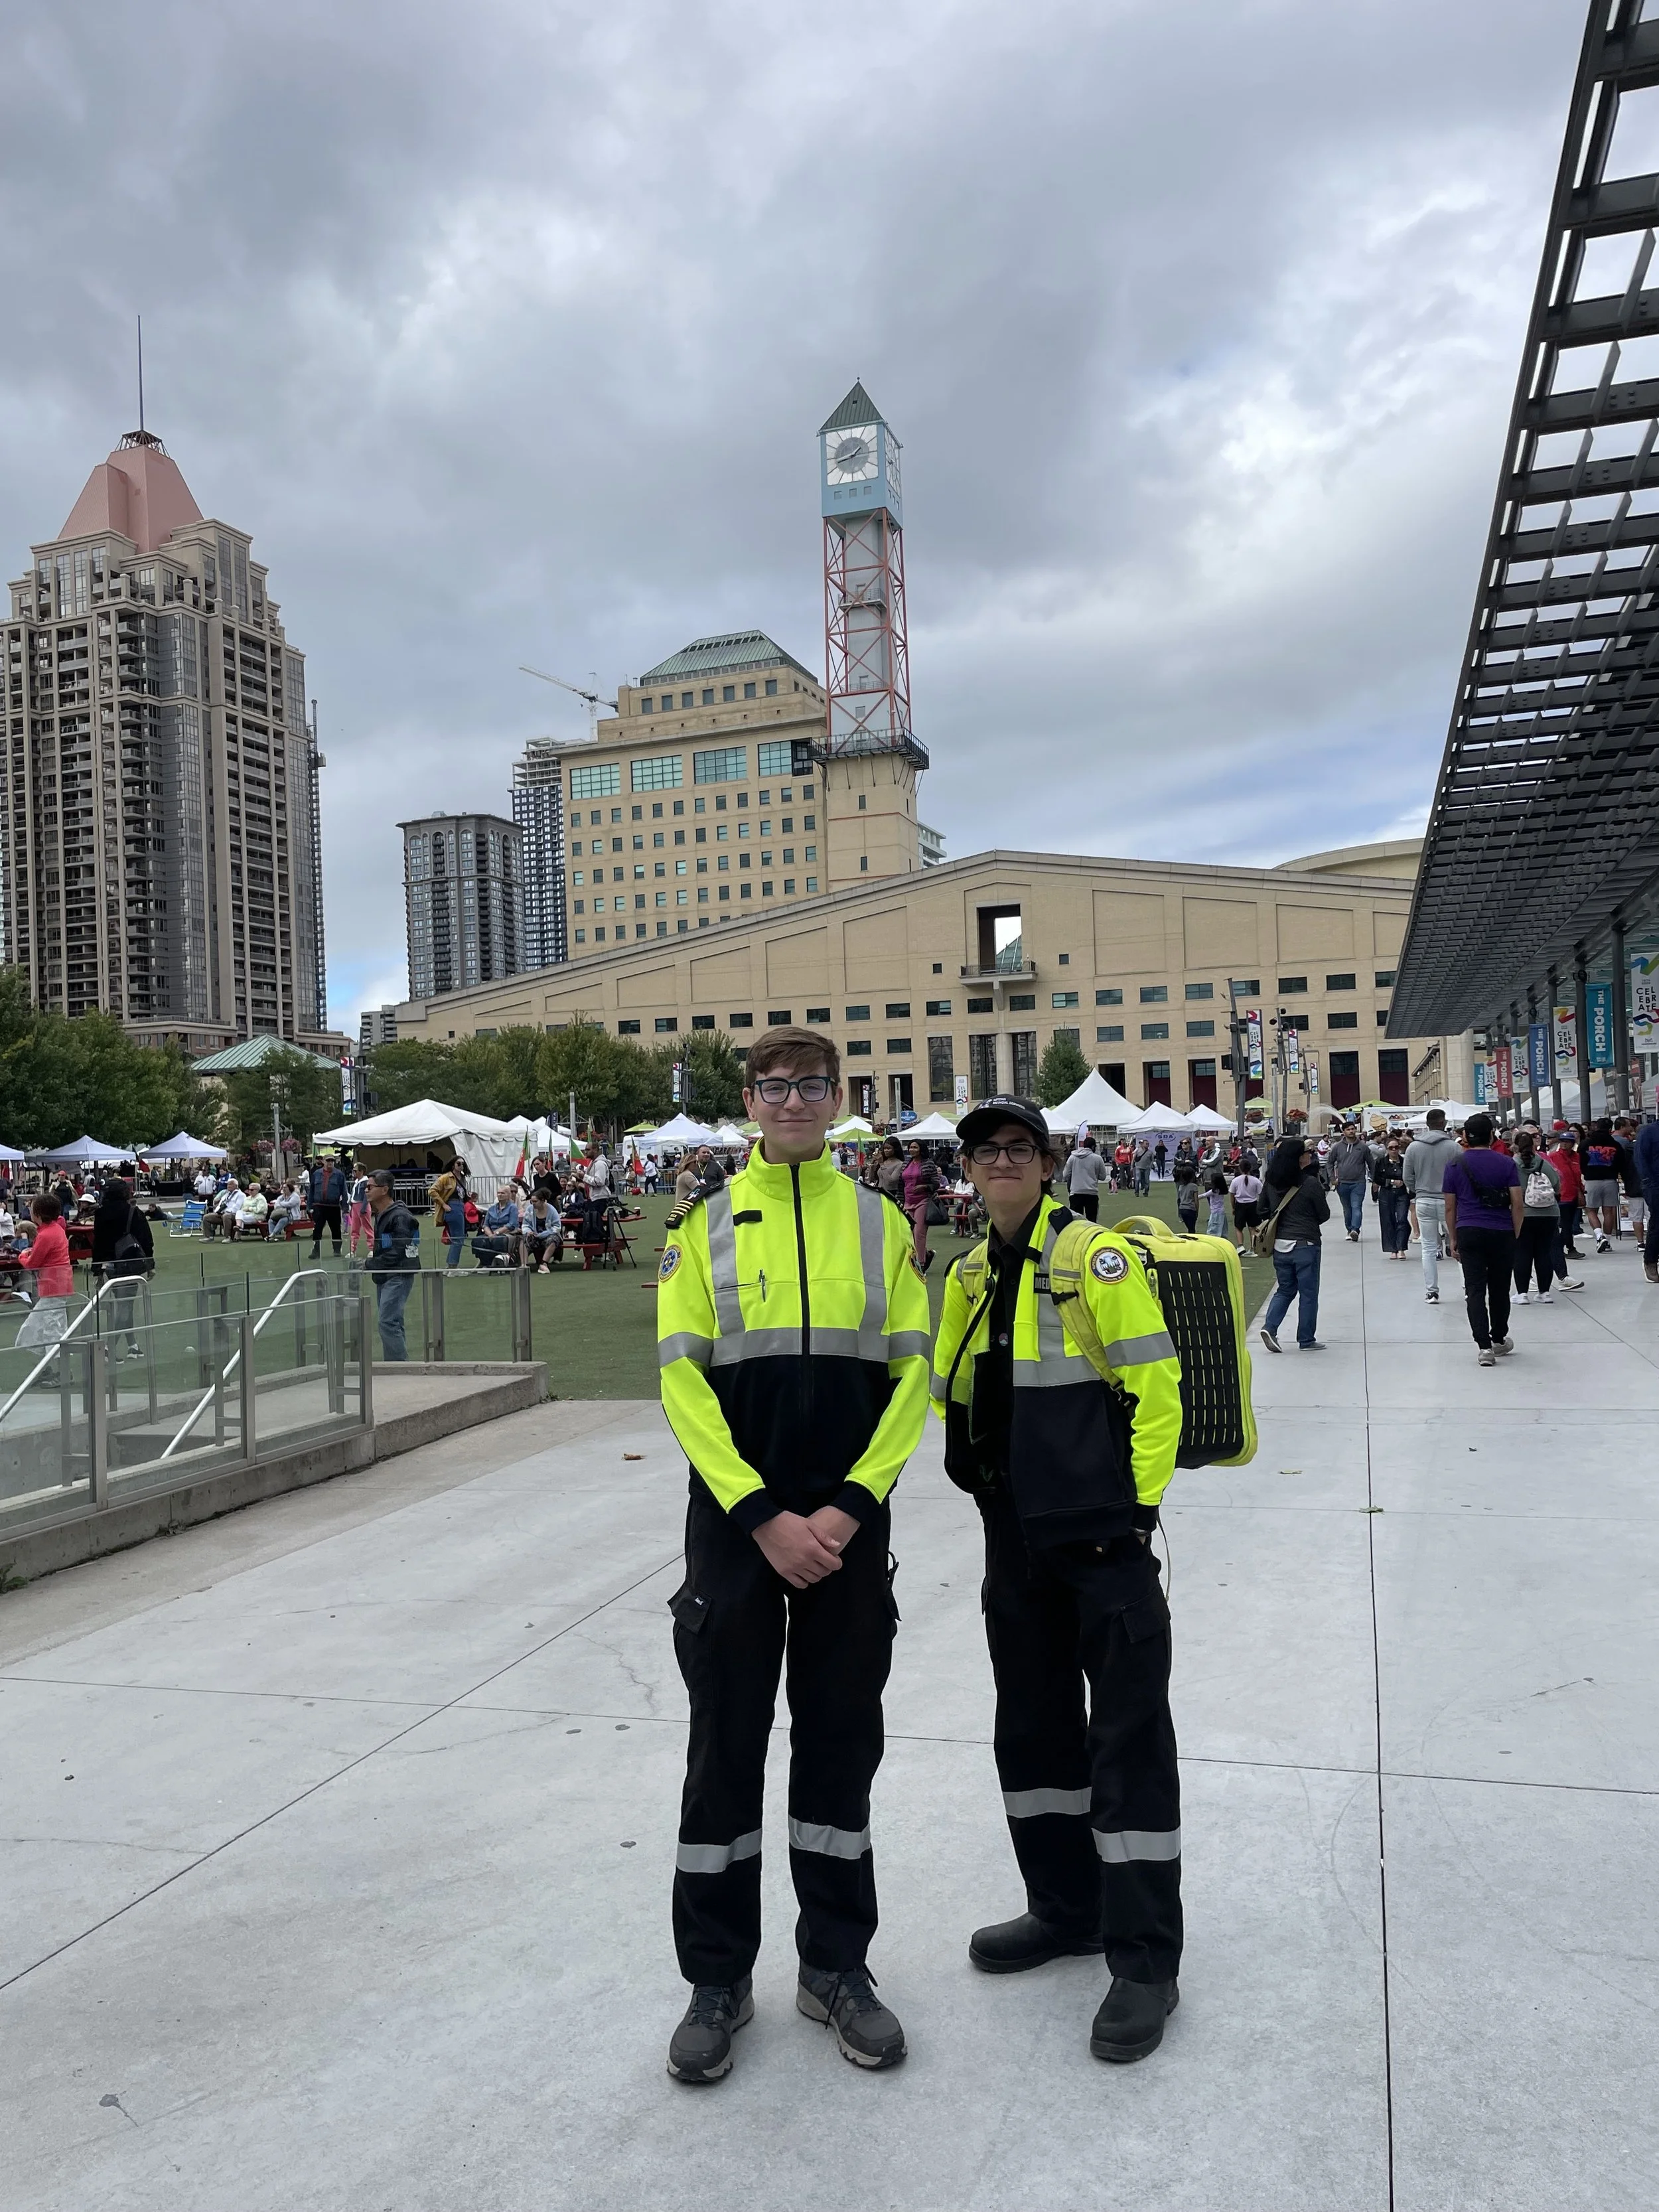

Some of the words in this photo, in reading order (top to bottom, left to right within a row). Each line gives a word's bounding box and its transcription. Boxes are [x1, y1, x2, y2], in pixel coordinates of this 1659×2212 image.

[1593, 1007, 1607, 1052] PORCH
[1500, 1061, 1508, 1088] PORCH
[1535, 1041, 1545, 1075] PORCH
